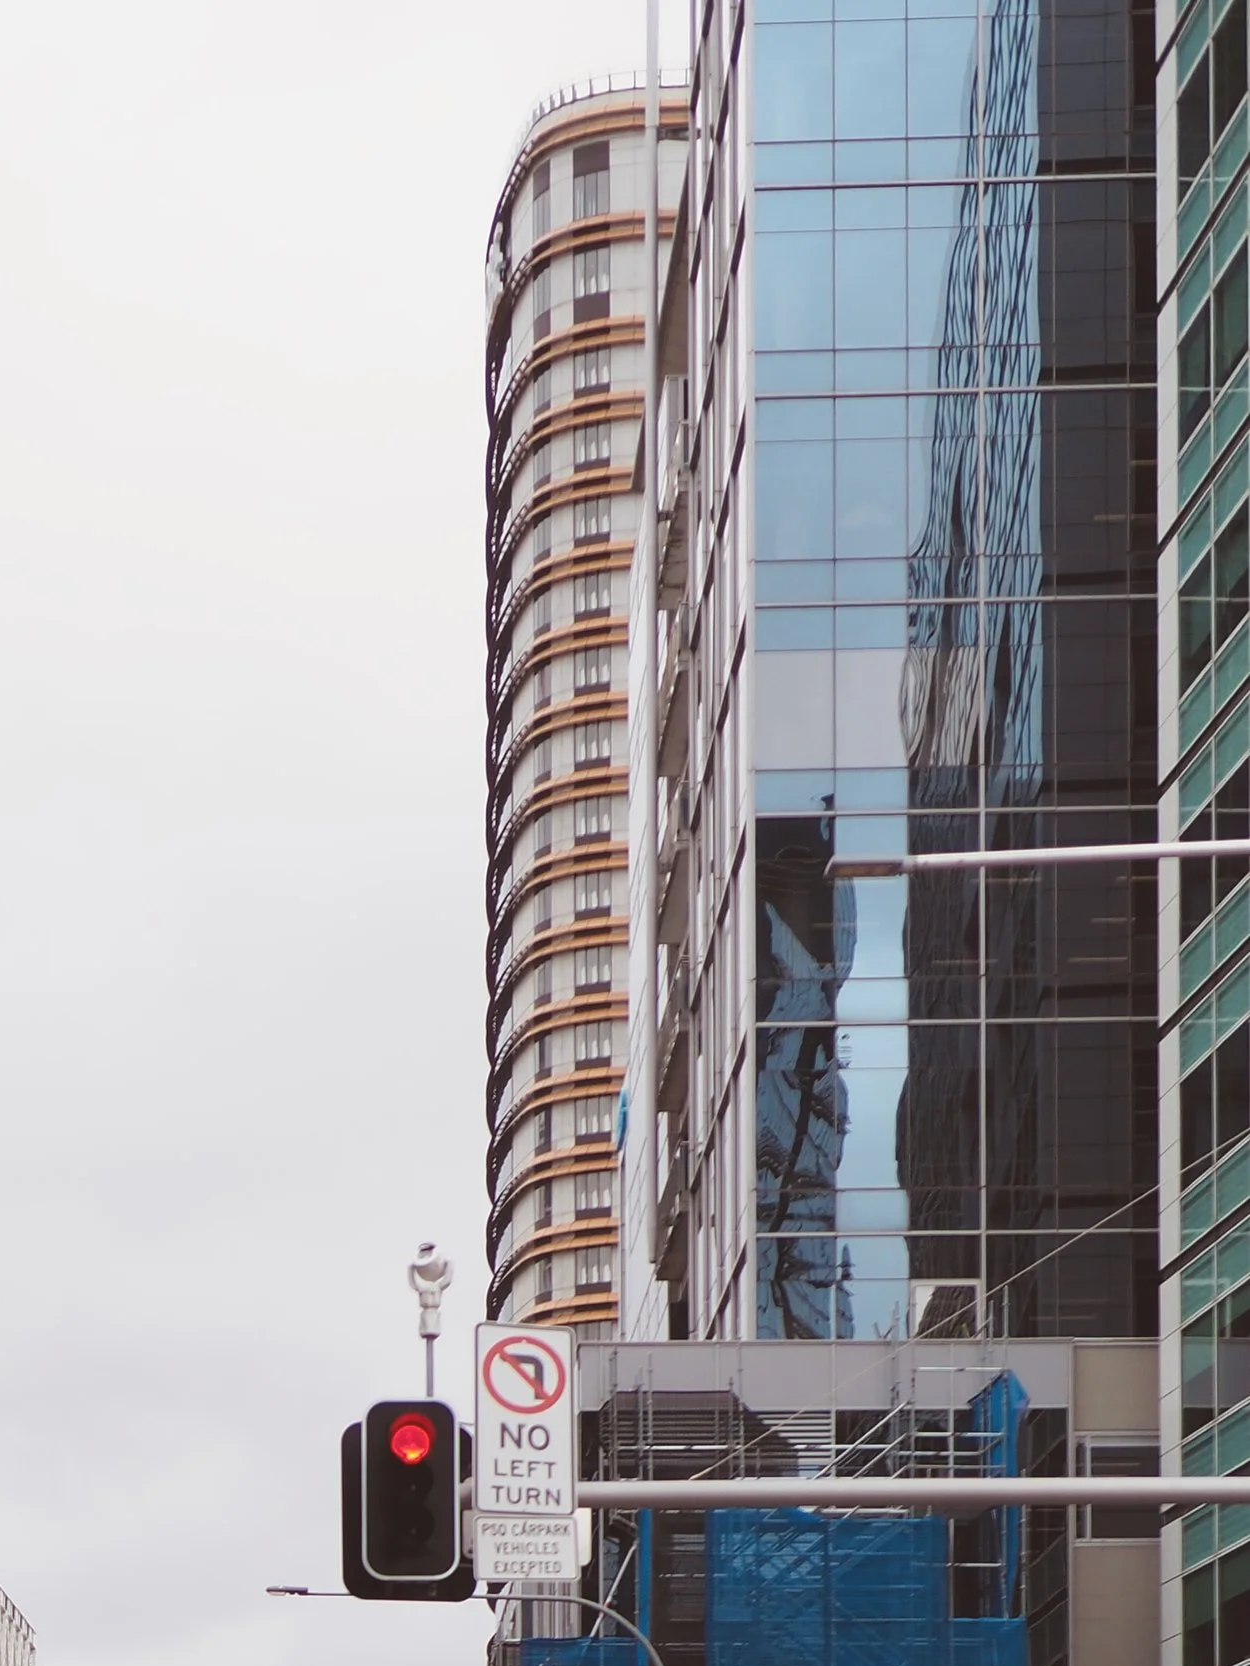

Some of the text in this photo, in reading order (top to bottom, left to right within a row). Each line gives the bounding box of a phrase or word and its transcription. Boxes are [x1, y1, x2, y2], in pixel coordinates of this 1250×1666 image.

[500, 1422, 550, 1450] NO
[494, 1458, 556, 1478] LEFT
[491, 1485, 561, 1506] TURN
[511, 1522, 570, 1536] CARPARK
[494, 1541, 559, 1555] VEHICLES
[493, 1560, 562, 1574] EXCEPTED
